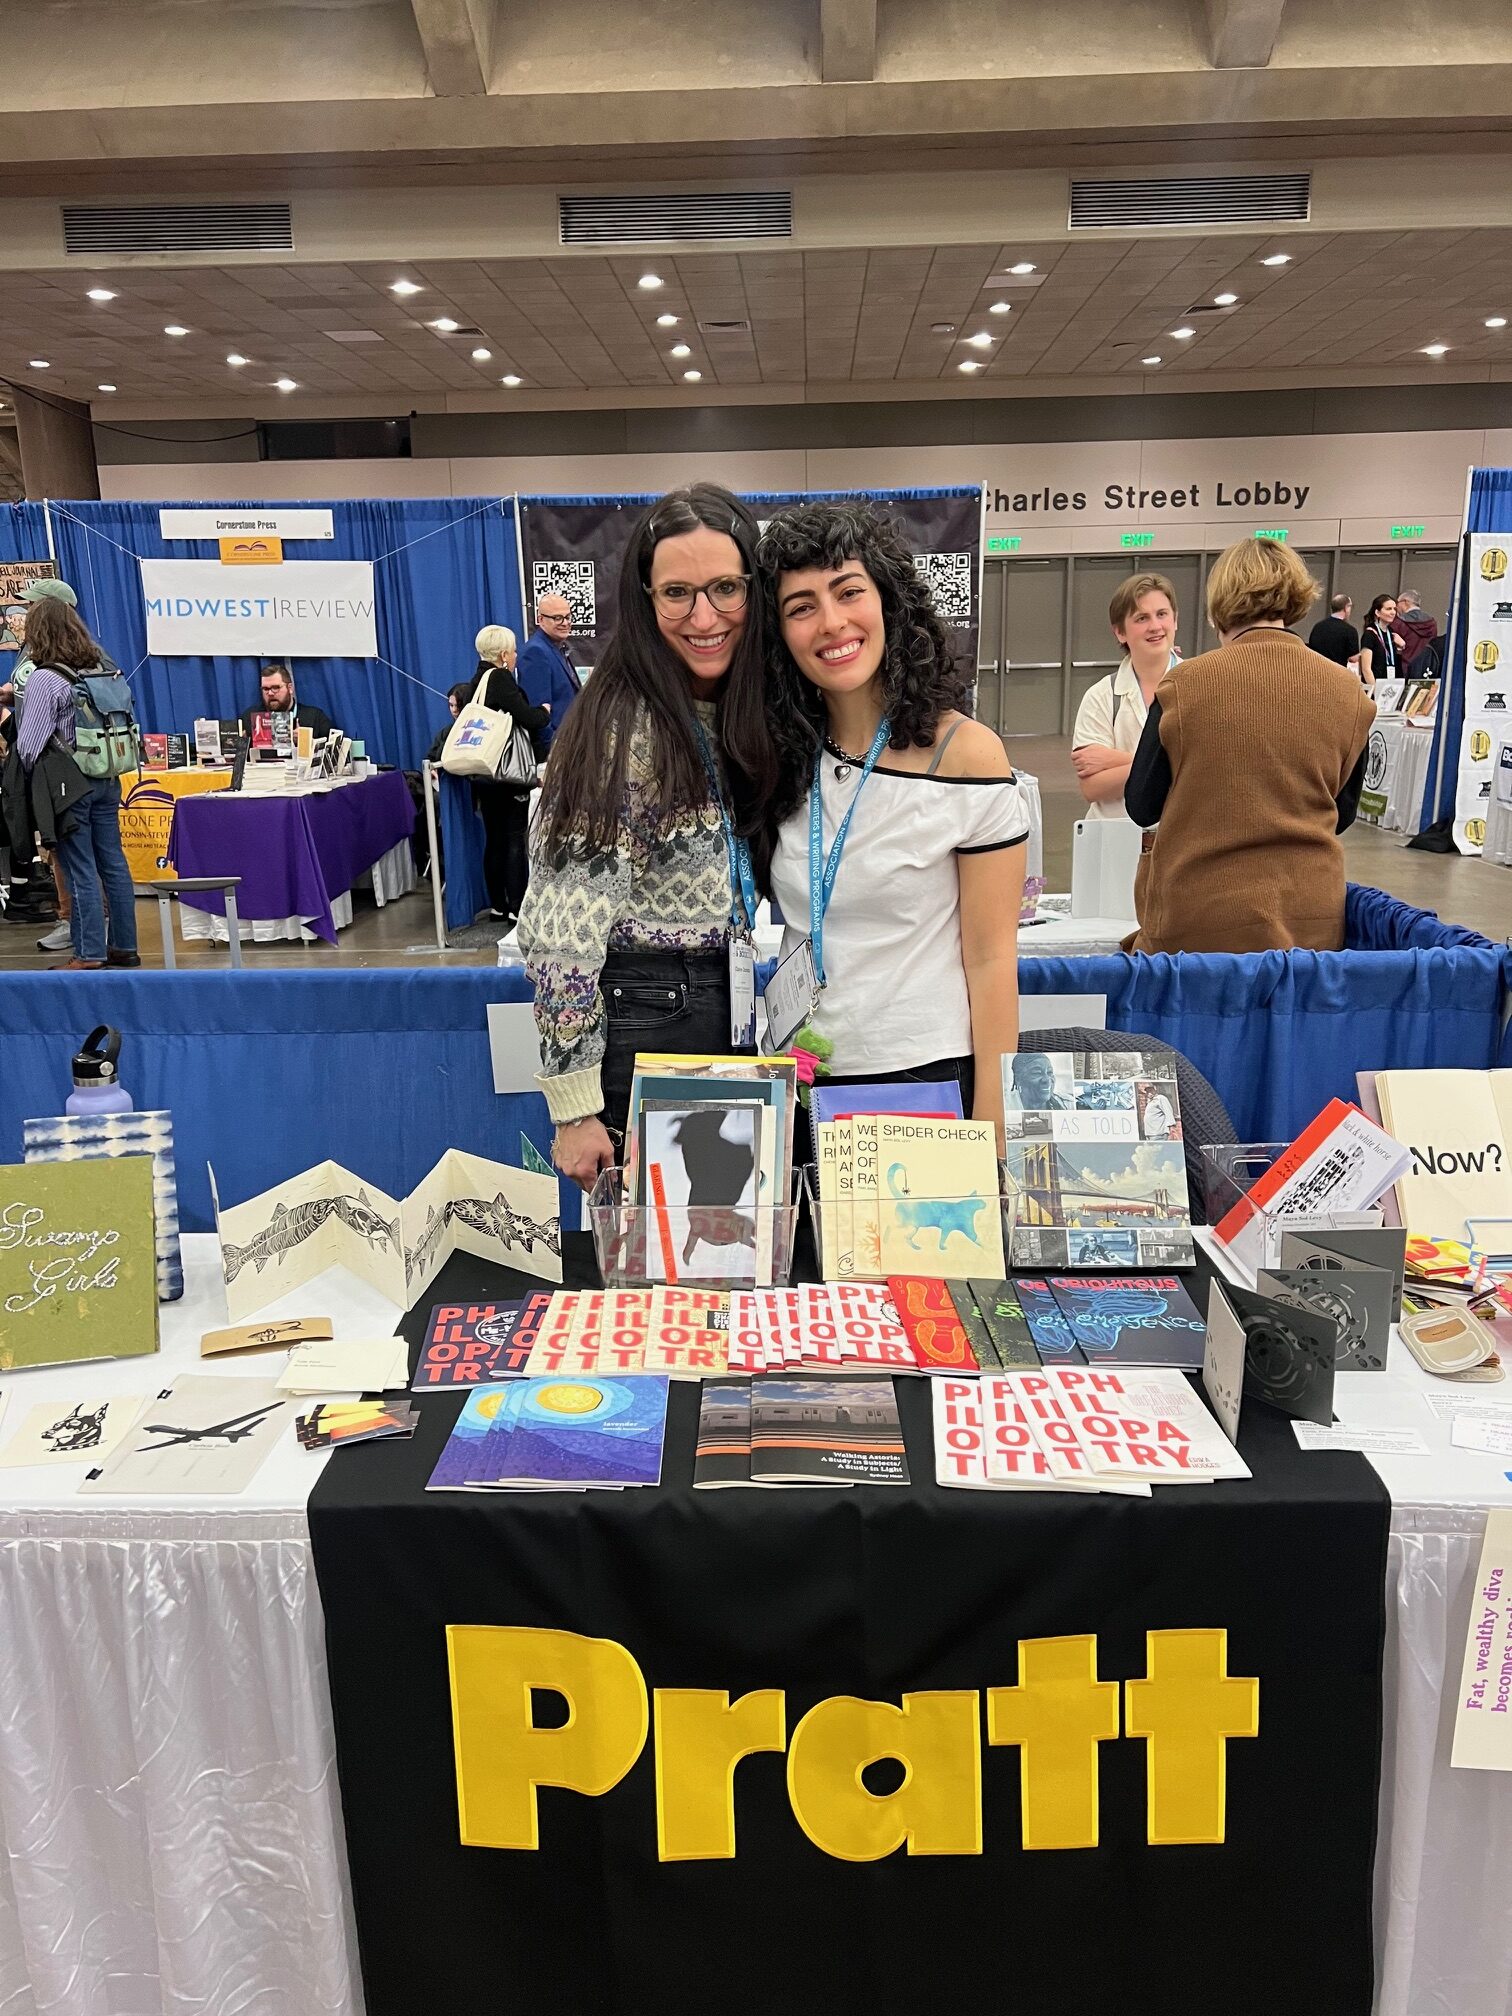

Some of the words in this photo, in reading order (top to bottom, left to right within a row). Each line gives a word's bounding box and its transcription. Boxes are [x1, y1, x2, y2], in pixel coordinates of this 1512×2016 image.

[1105, 484, 1200, 510] Street
[1217, 481, 1310, 510] Lobby
[216, 520, 256, 529] Cornerstone
[258, 520, 277, 529] Press
[1391, 525, 1425, 539] EXIT
[988, 537, 1022, 551] EXIT
[1120, 533, 1155, 547] EXIT
[146, 598, 270, 617] MIDWEST
[281, 599, 374, 619] REVIEW
[867, 731, 886, 769] WRITING
[812, 841, 820, 878] WRITING
[824, 827, 846, 888] ASSOCIATION
[812, 880, 820, 932] PROGRAMS
[883, 1124, 933, 1138] SPIDER
[937, 1128, 987, 1141] CHECK
[1060, 1118, 1080, 1135] AS
[1093, 1117, 1132, 1135] TOLD
[1358, 1131, 1375, 1149] white
[1374, 1143, 1393, 1161] horse
[857, 1156, 877, 1168] OF
[1409, 1143, 1502, 1176] Now?
[858, 1173, 878, 1185] RA
[5, 1257, 121, 1312] Girls
[1051, 1278, 1179, 1291] UBIQUITOUS
[423, 1362, 495, 1382] TR
[1057, 1371, 1125, 1393] PH
[1067, 1393, 1120, 1415] IL
[1082, 1416, 1191, 1442] OPA
[829, 1457, 851, 1465] Study
[833, 1452, 867, 1461] Walking
[1091, 1440, 1191, 1468] TRY
[1483, 1568, 1504, 1601] diva
[1476, 1607, 1499, 1671] wealthy
[1491, 1645, 1512, 1713] becomes
[1466, 1678, 1489, 1709] Fat,
[446, 1624, 1260, 1863] Pratt
